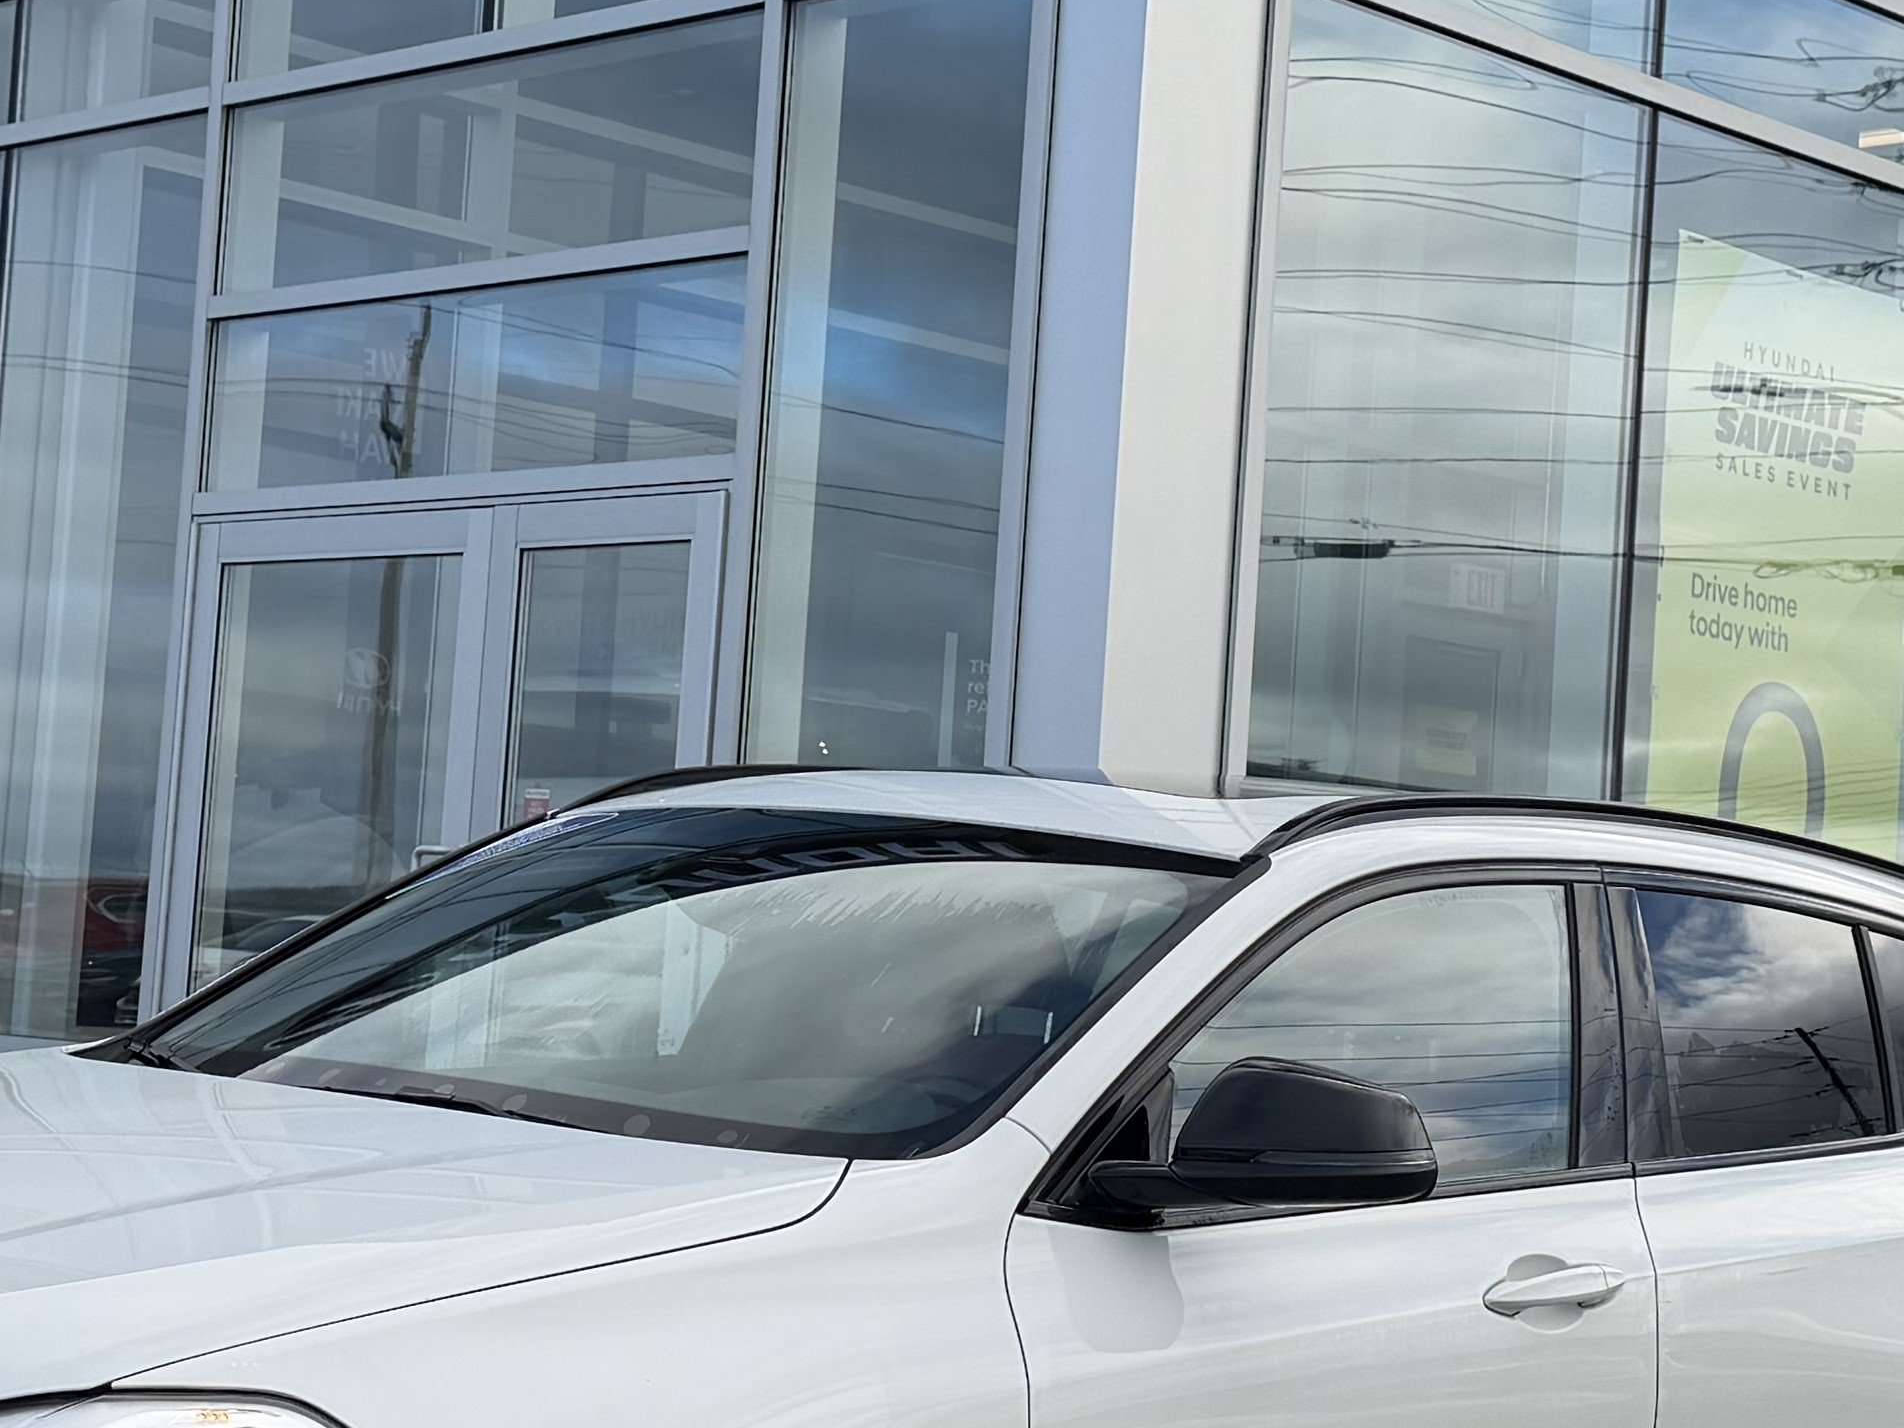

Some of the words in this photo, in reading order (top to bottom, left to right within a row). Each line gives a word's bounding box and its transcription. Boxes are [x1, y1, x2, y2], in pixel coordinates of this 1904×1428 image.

[1744, 341, 1835, 382] HYUNDAI
[1714, 407, 1856, 474] SAVINGS
[1715, 452, 1776, 483] SALES
[1786, 470, 1852, 501] EVENT
[1690, 572, 1739, 607] Drive
[1743, 581, 1798, 618] home
[1689, 609, 1744, 649] today
[1748, 621, 1789, 653] with
